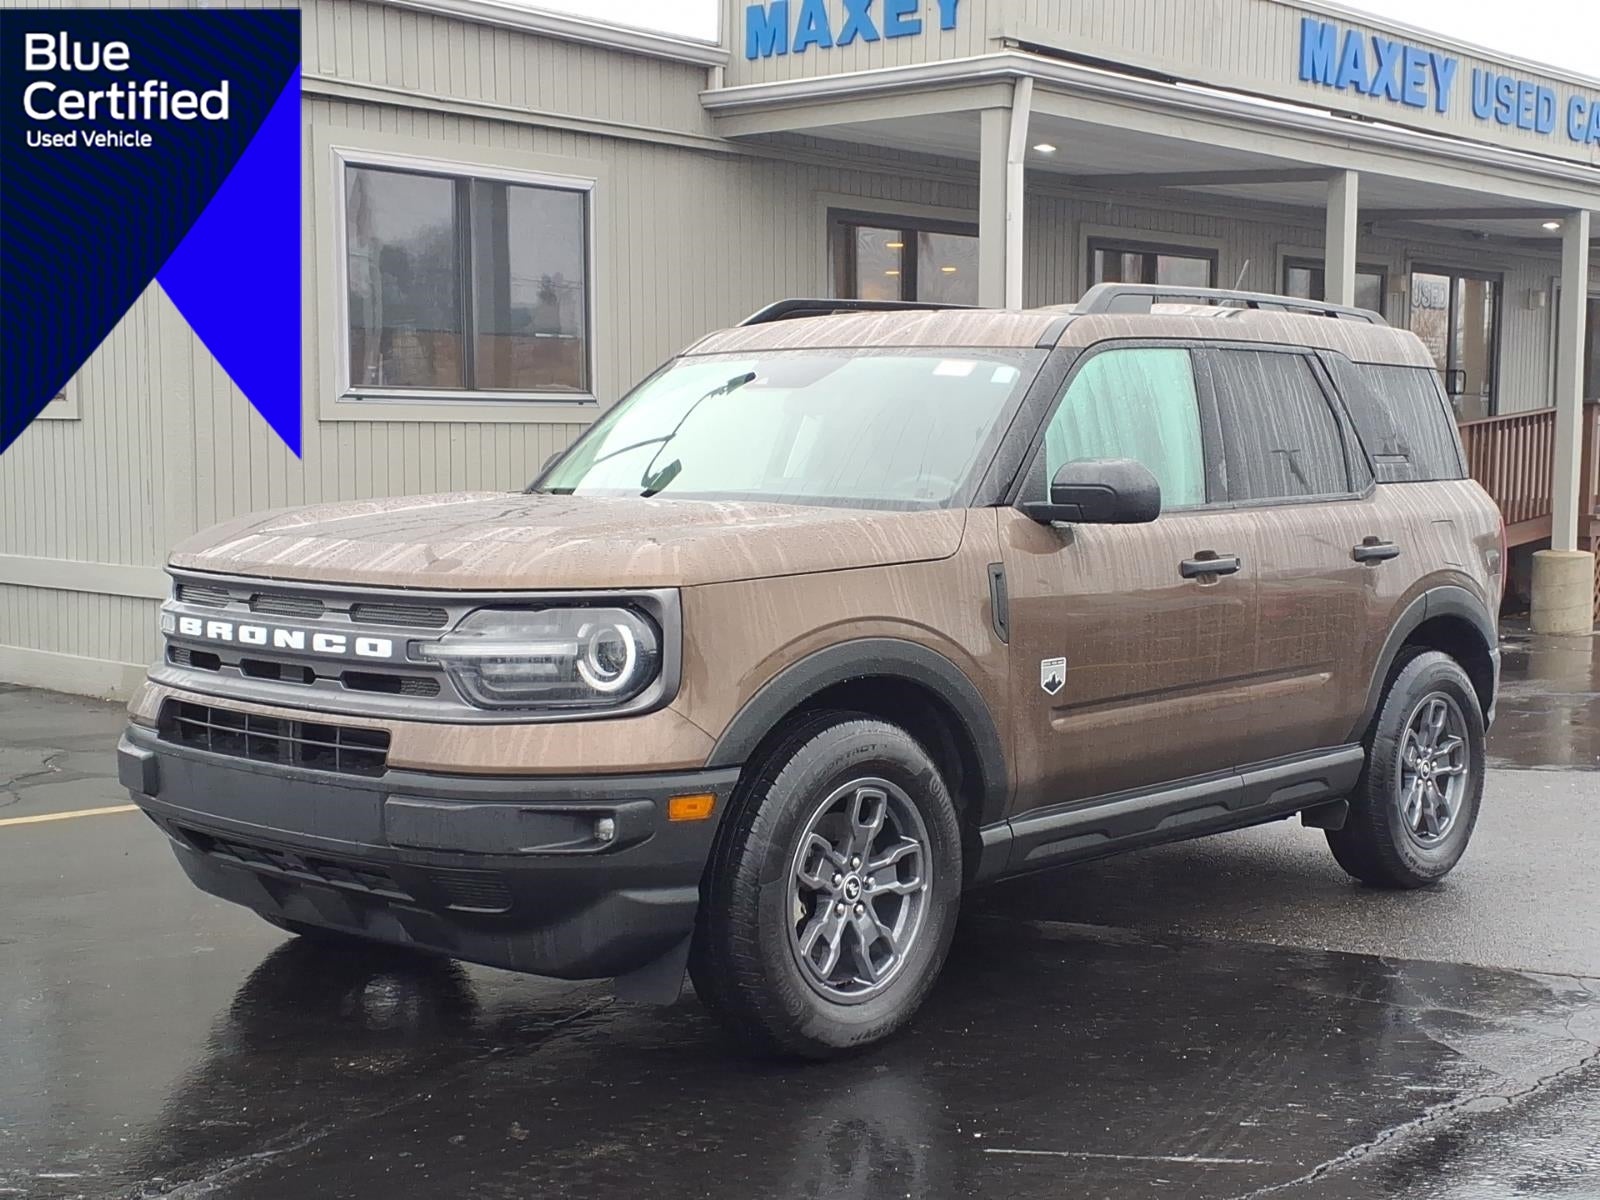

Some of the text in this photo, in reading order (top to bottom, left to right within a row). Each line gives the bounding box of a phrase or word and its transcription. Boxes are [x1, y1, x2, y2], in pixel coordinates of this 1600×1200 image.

[746, 0, 959, 60] MAXEY
[1300, 17, 1457, 113] MAXEY
[1472, 68, 1557, 134] USED
[1411, 280, 1447, 309] USED
[179, 616, 393, 658] BRONCO
